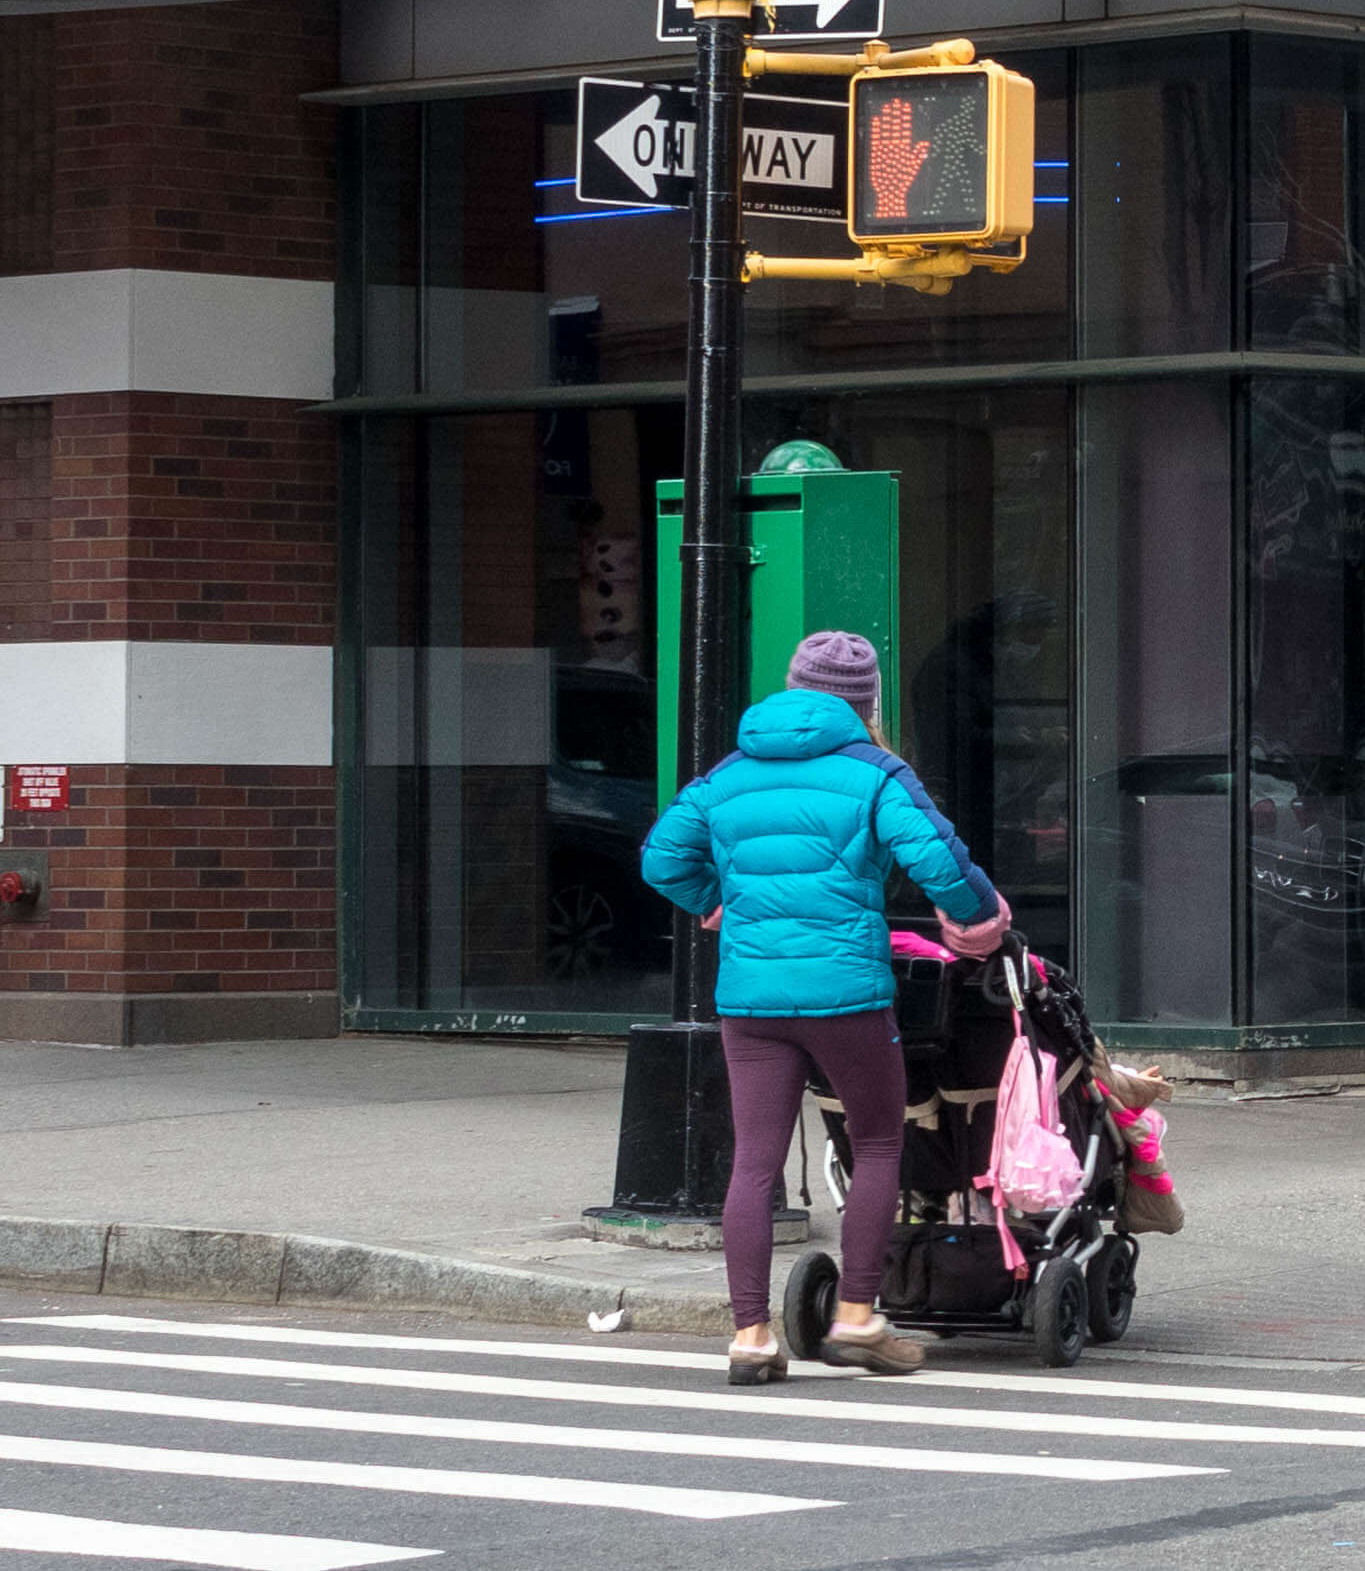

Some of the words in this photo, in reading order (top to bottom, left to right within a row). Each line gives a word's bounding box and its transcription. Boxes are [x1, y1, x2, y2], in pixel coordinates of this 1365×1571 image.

[633, 123, 696, 171] ON
[742, 134, 817, 181] WAY
[769, 203, 842, 216] TRANSPORTATION
